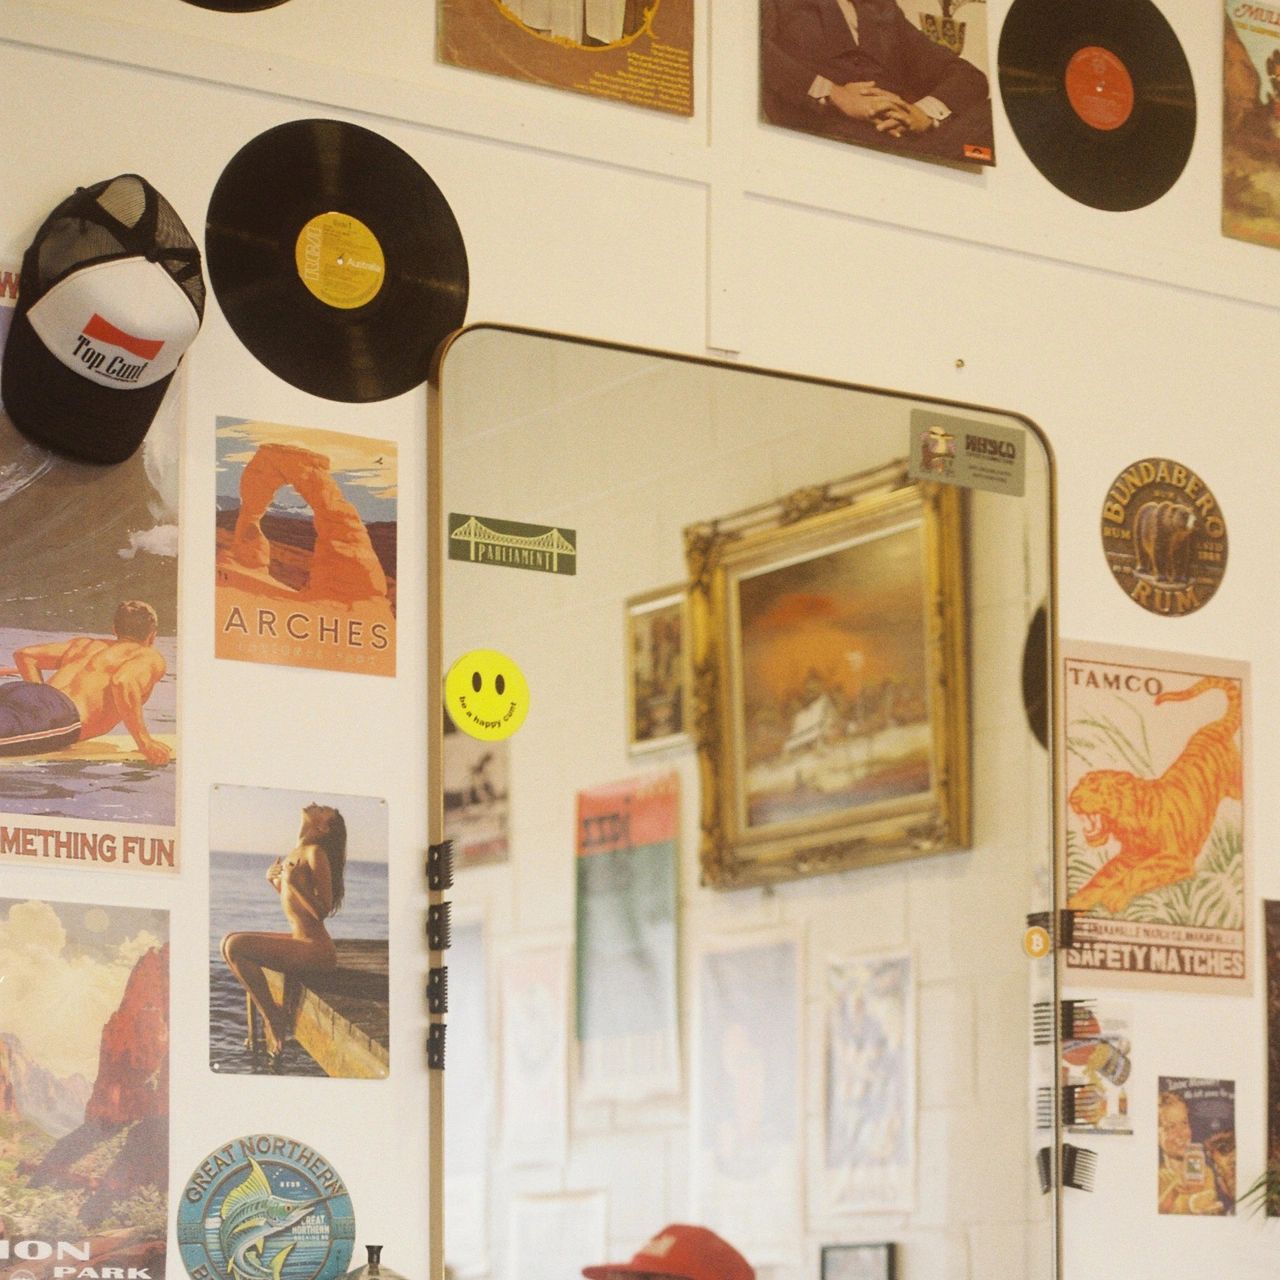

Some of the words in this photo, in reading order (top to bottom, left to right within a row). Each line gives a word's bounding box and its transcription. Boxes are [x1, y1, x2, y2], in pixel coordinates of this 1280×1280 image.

[73, 335, 102, 369] Top
[106, 356, 149, 380] Cunt
[478, 543, 551, 570] PARLIAMENT
[1132, 580, 1201, 613] RUM
[224, 606, 389, 650] ARCHES
[1069, 667, 1163, 697] TAMCO
[473, 715, 502, 729] happy
[0, 826, 117, 863] METHING
[122, 835, 175, 867] FUN
[1068, 942, 1149, 971] SAFETY
[1150, 947, 1245, 977] MATCHES
[186, 1143, 238, 1204] GREAT
[240, 1135, 345, 1194] NORTHERN
[0, 1240, 91, 1262] ION
[53, 1266, 153, 1280] PARK
